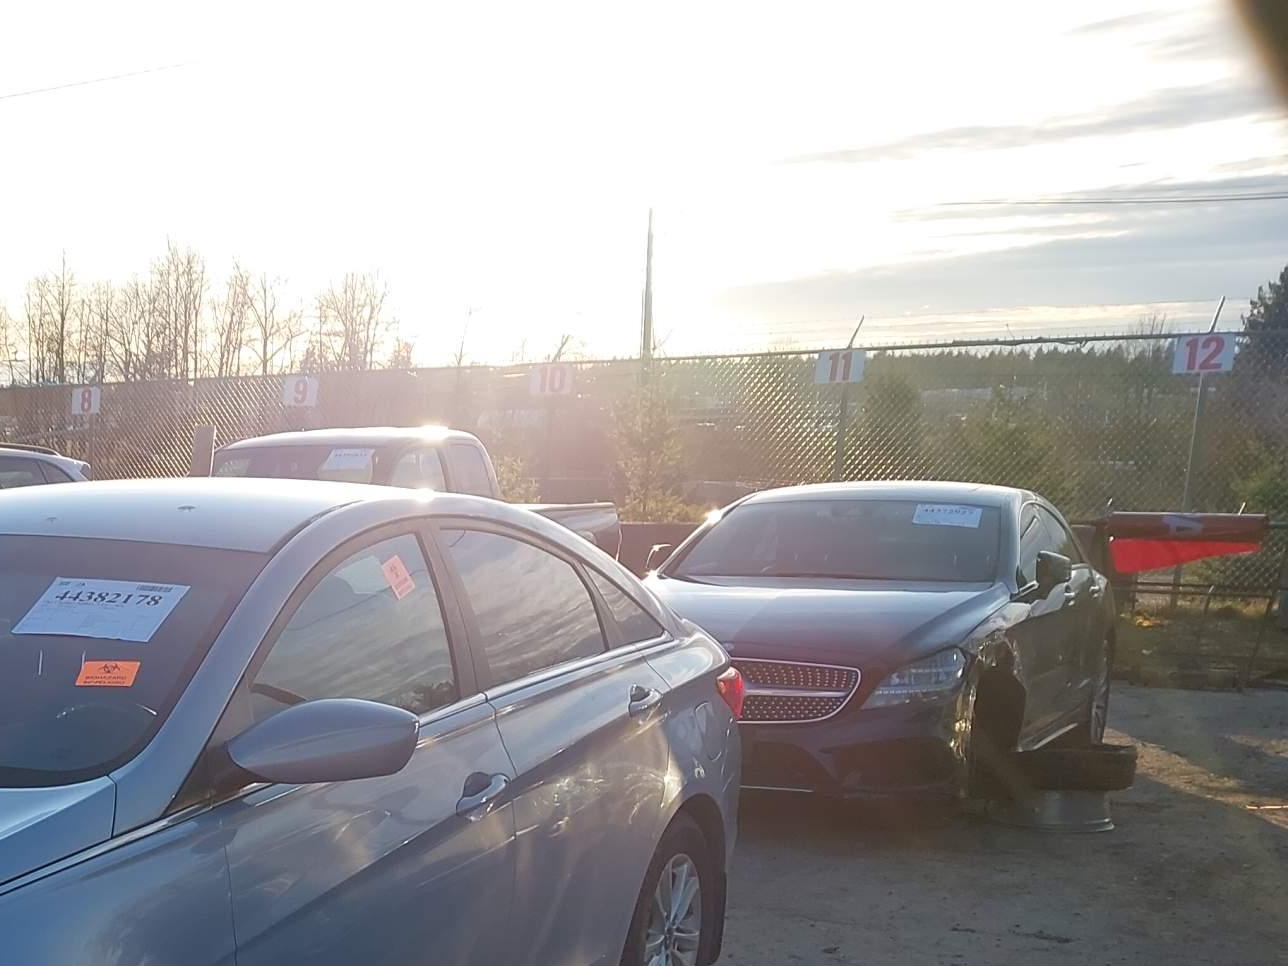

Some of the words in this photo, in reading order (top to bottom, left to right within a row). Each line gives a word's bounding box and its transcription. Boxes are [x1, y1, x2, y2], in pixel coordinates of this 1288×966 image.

[1186, 335, 1224, 370] 12
[540, 366, 568, 392] 10
[829, 351, 852, 382] 11
[81, 388, 92, 411] 8
[294, 379, 307, 403] 9
[55, 590, 163, 606] 44382178
